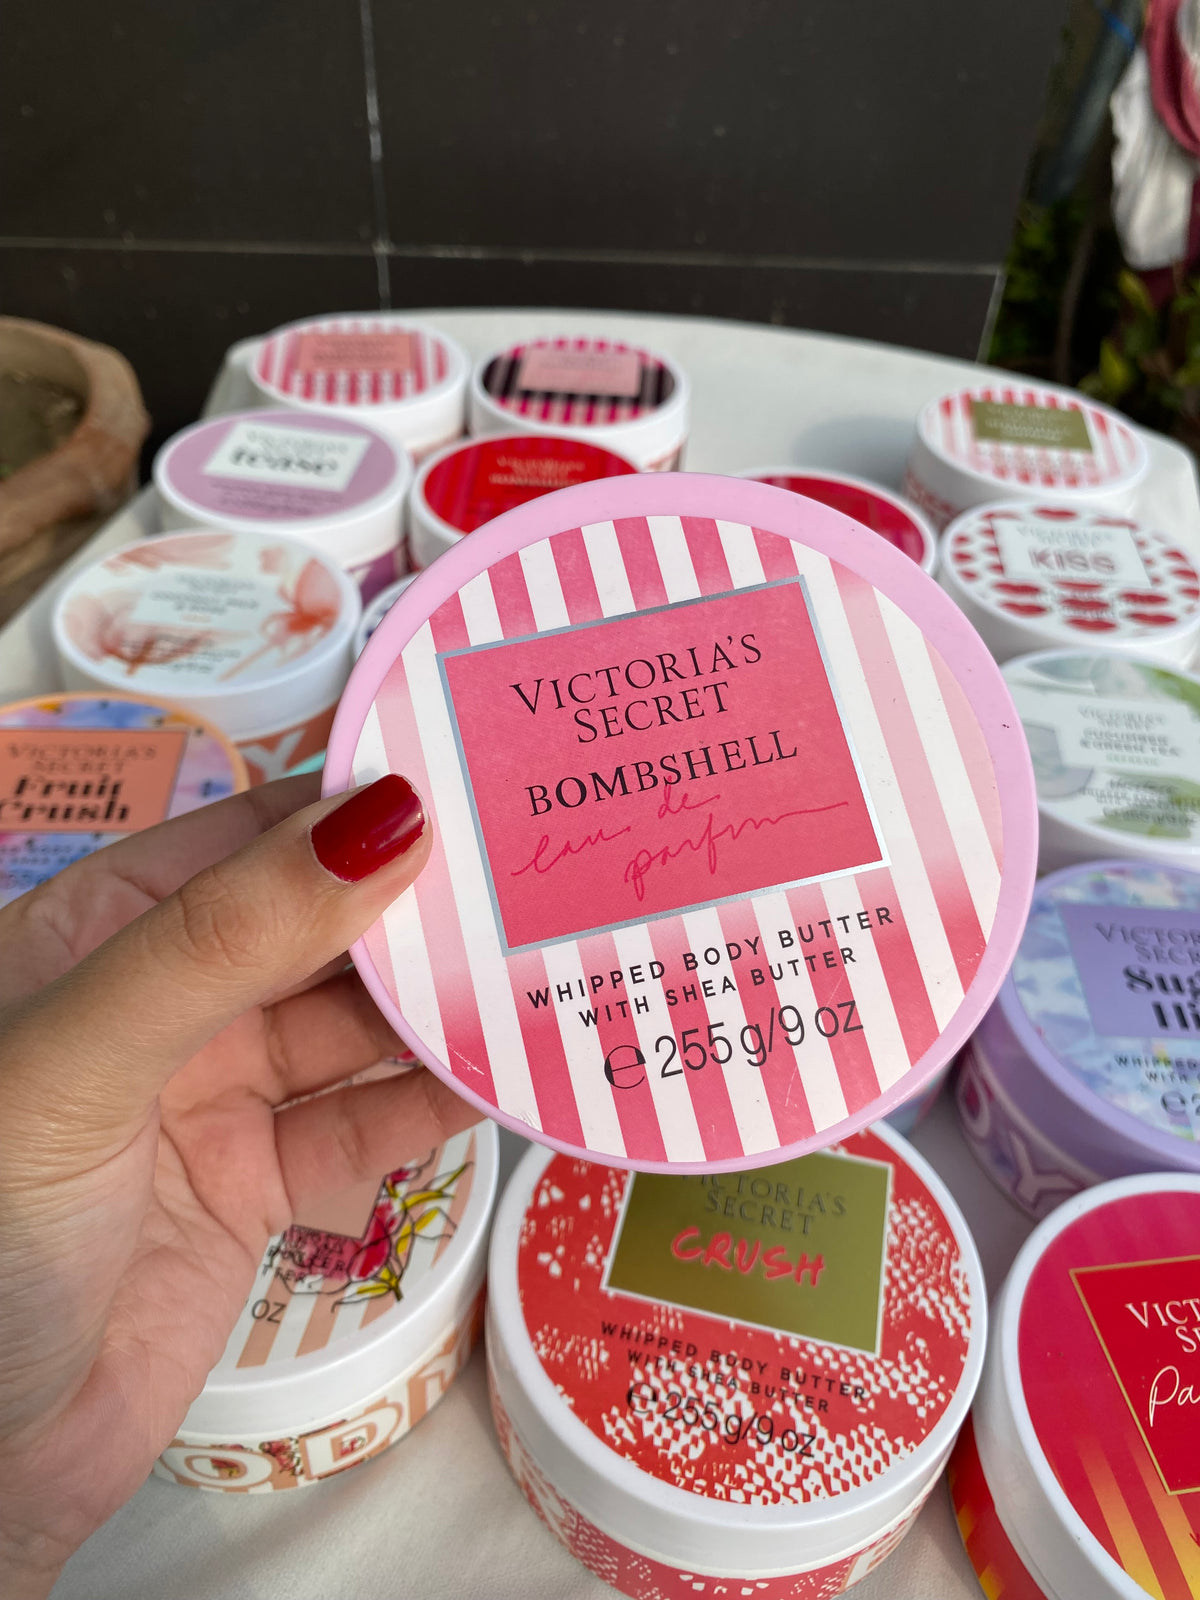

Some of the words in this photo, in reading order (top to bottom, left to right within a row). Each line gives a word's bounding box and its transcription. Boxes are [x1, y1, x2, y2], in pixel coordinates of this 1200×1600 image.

[1028, 547, 1118, 575] KISS
[509, 633, 762, 716] VICTORIA'S
[573, 681, 729, 743] SECRET
[525, 730, 797, 816] BOMBSHELL
[657, 775, 720, 819] de
[527, 960, 666, 1009] WHIPPED
[683, 936, 760, 972] BODY
[778, 907, 893, 949] BUTTER
[579, 996, 650, 1028] WITH
[666, 975, 736, 1008] SHEA
[751, 947, 856, 986] BUTTER
[682, 1174, 847, 1216] ICTORIA'S
[704, 1190, 814, 1235] SECRET
[671, 1225, 825, 1288] CRUSH
[601, 1321, 698, 1356] WHIPPED
[710, 1349, 768, 1375] BODY
[780, 1367, 867, 1400] BUTTER
[627, 1348, 677, 1374] WITH
[688, 1366, 739, 1390] SHEA
[751, 1382, 829, 1412] BUTTER
